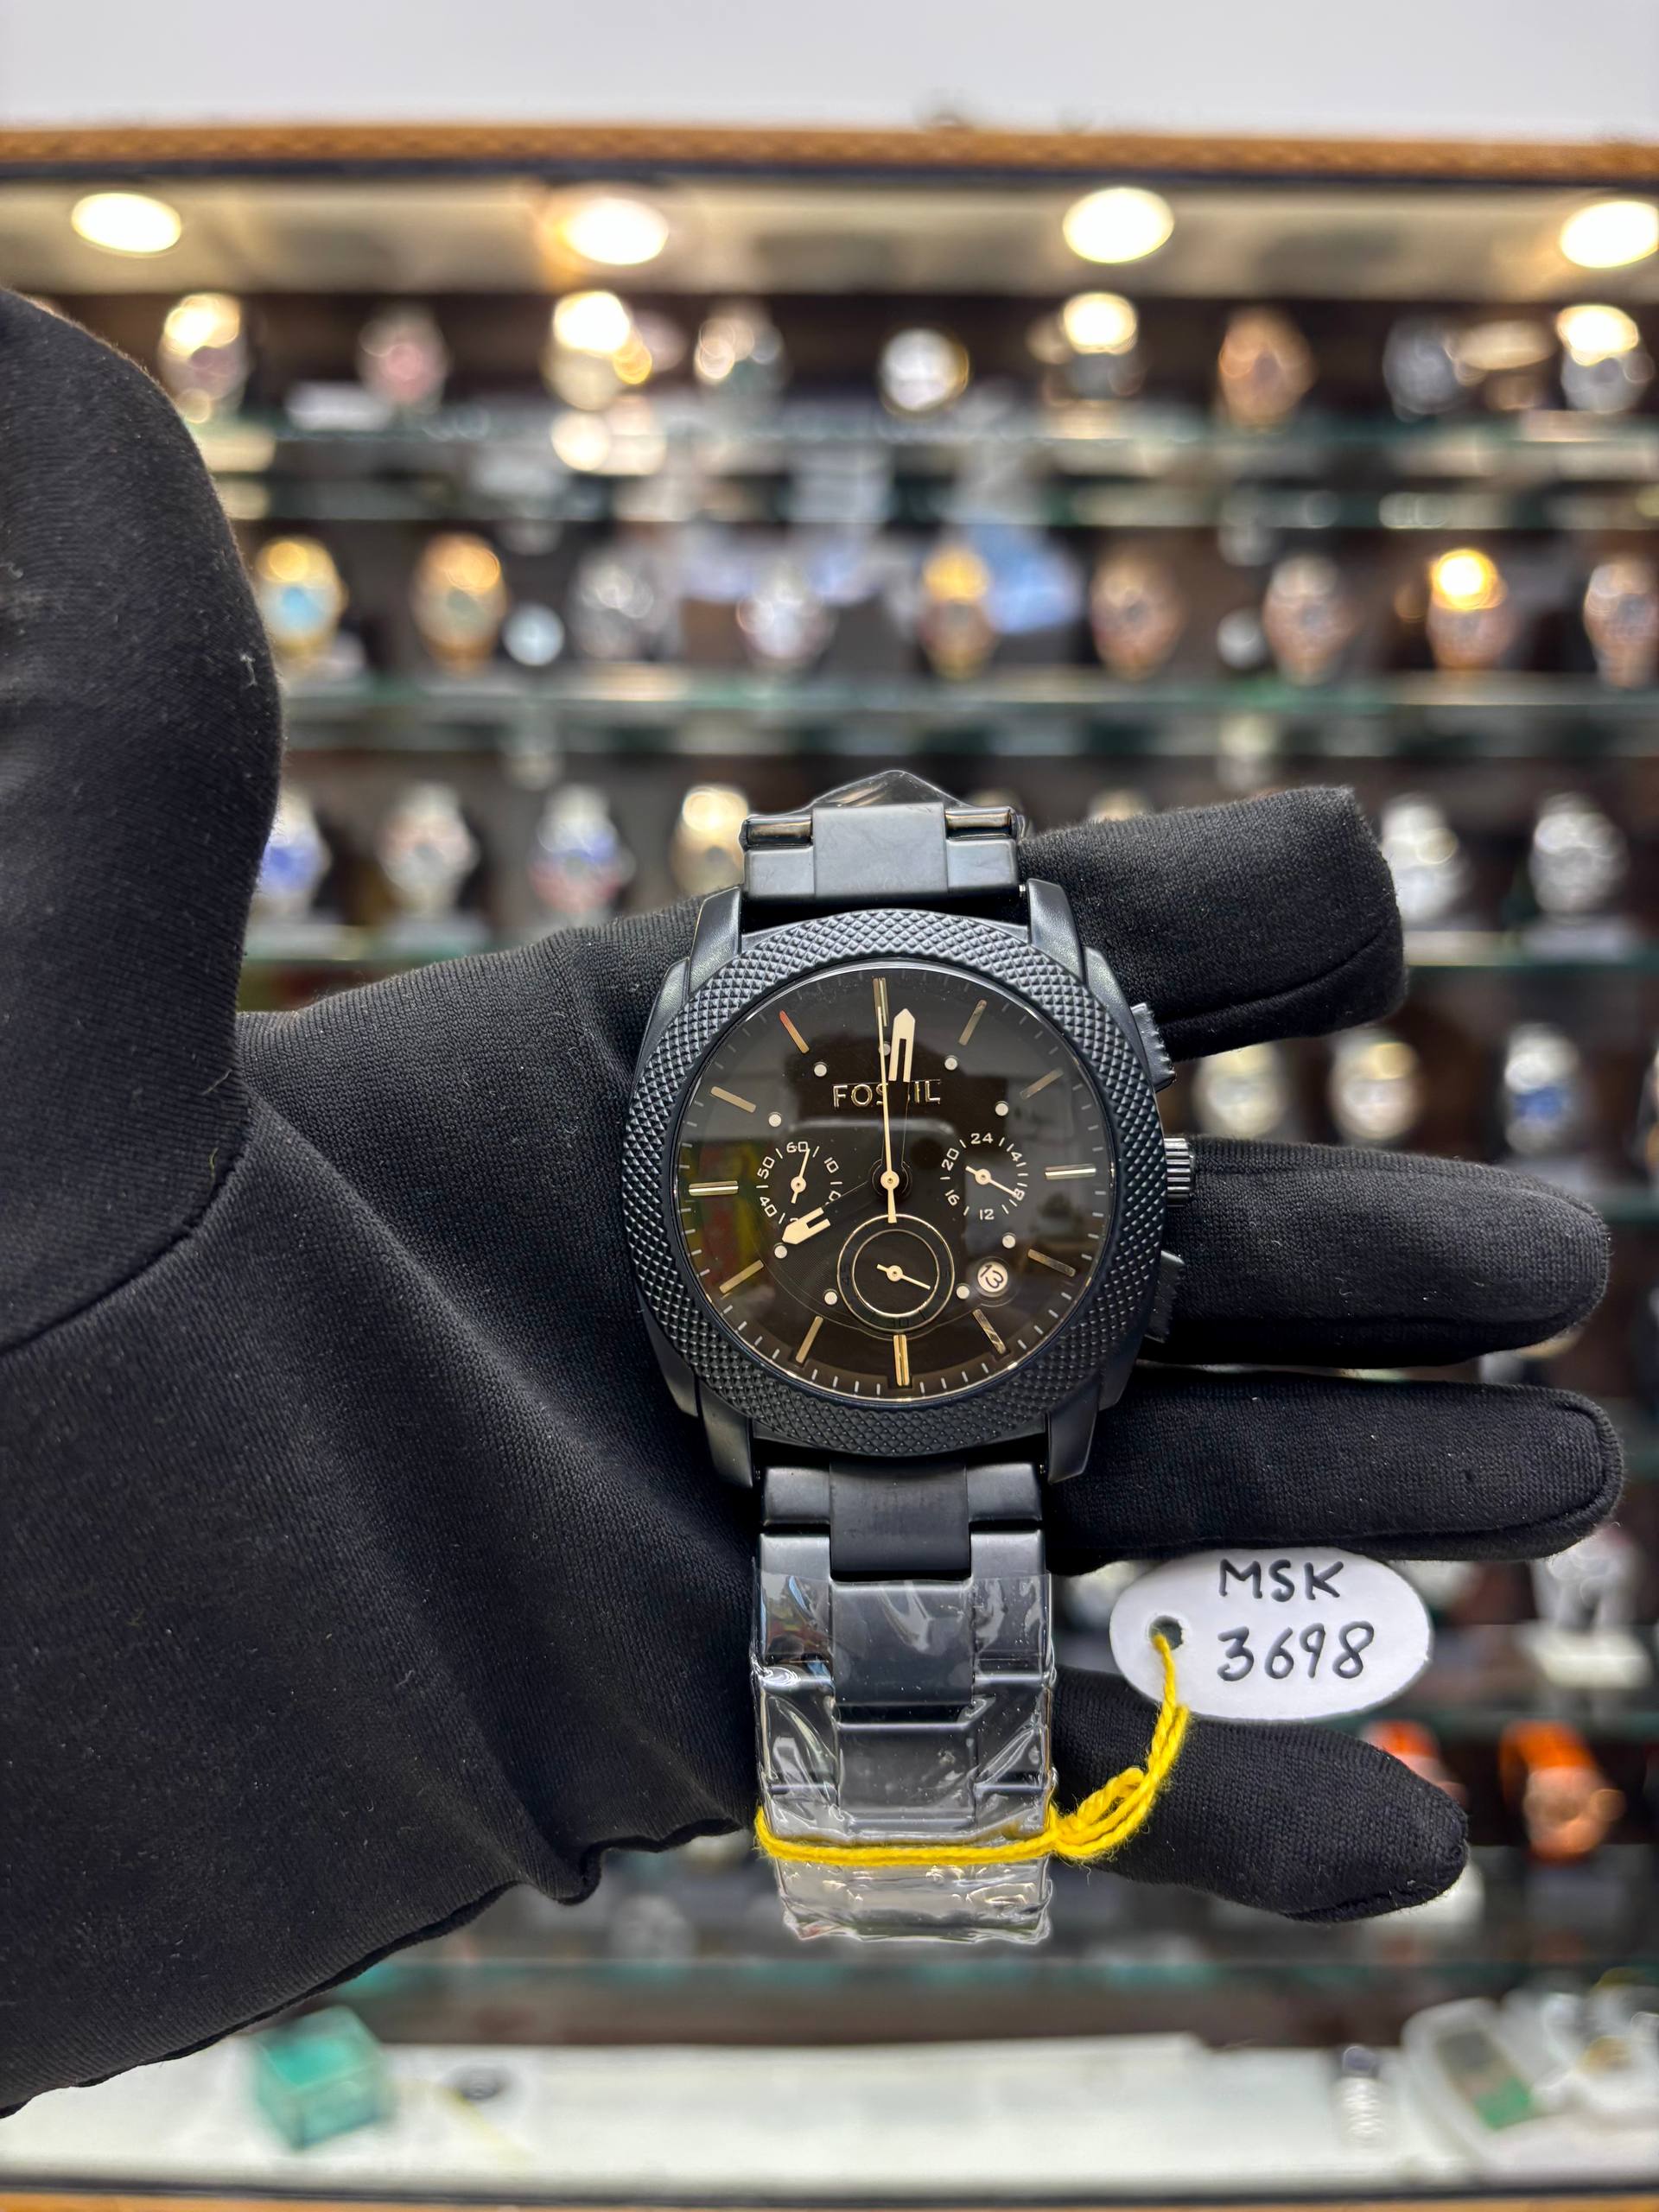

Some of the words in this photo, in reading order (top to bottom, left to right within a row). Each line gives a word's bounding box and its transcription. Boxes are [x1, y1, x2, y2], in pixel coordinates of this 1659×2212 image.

[786, 1141, 809, 1153] 60
[970, 1133, 994, 1144] 24
[757, 1156, 775, 1179] 50
[823, 1157, 839, 1173] 10
[941, 1147, 960, 1171] 20
[760, 1196, 778, 1217] 40
[944, 1189, 960, 1206] 16
[979, 1209, 995, 1220] 12
[980, 1264, 1004, 1289] 13
[1218, 1559, 1344, 1602] MSK
[1217, 1620, 1375, 1681] 3698
